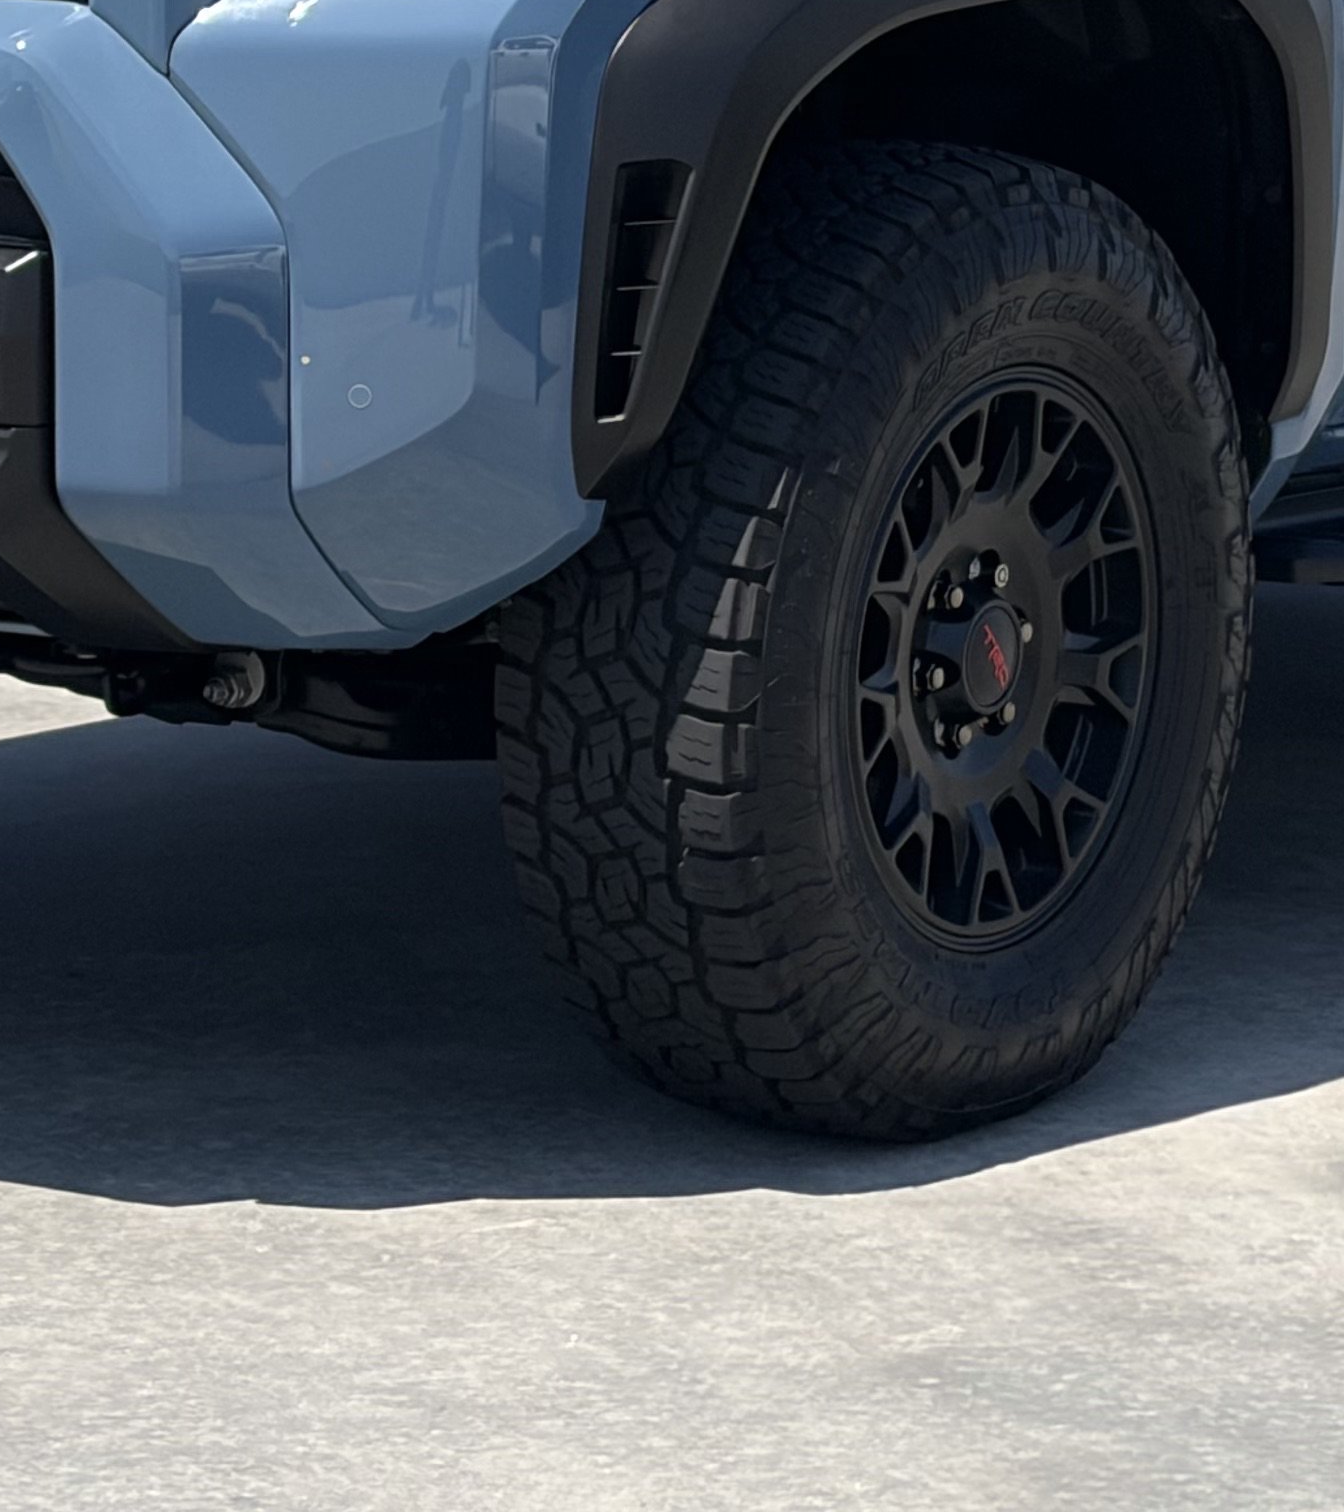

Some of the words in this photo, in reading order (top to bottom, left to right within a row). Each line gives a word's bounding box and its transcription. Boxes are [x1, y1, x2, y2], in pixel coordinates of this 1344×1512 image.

[913, 296, 1027, 411] OPEN
[1028, 289, 1192, 433] COUNTRY
[982, 623, 1010, 693] TRD
